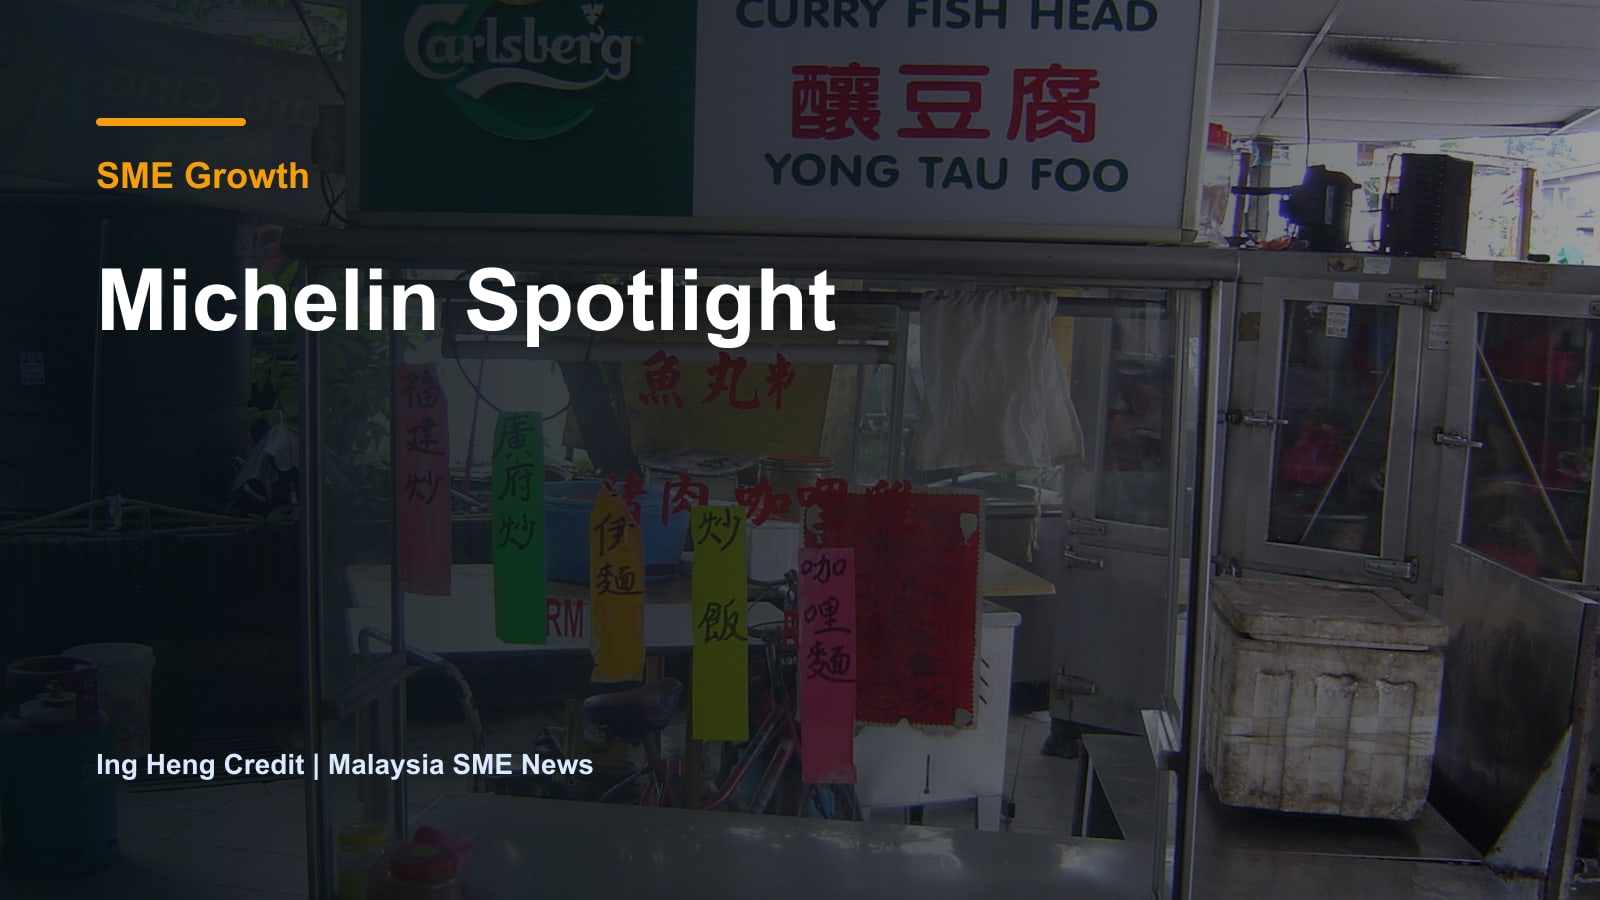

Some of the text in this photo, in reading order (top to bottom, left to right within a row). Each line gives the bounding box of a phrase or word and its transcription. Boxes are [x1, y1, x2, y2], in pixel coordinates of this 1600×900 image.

[736, 0, 1158, 31] CURRY FISH HEAD
[403, 3, 633, 81] Carlsberg
[791, 62, 1100, 143] 釀豆腐
[765, 153, 1128, 192] YONG TAU FOO
[403, 368, 447, 505] 福建炒
[546, 598, 584, 637] RM
[783, 610, 801, 650] R
